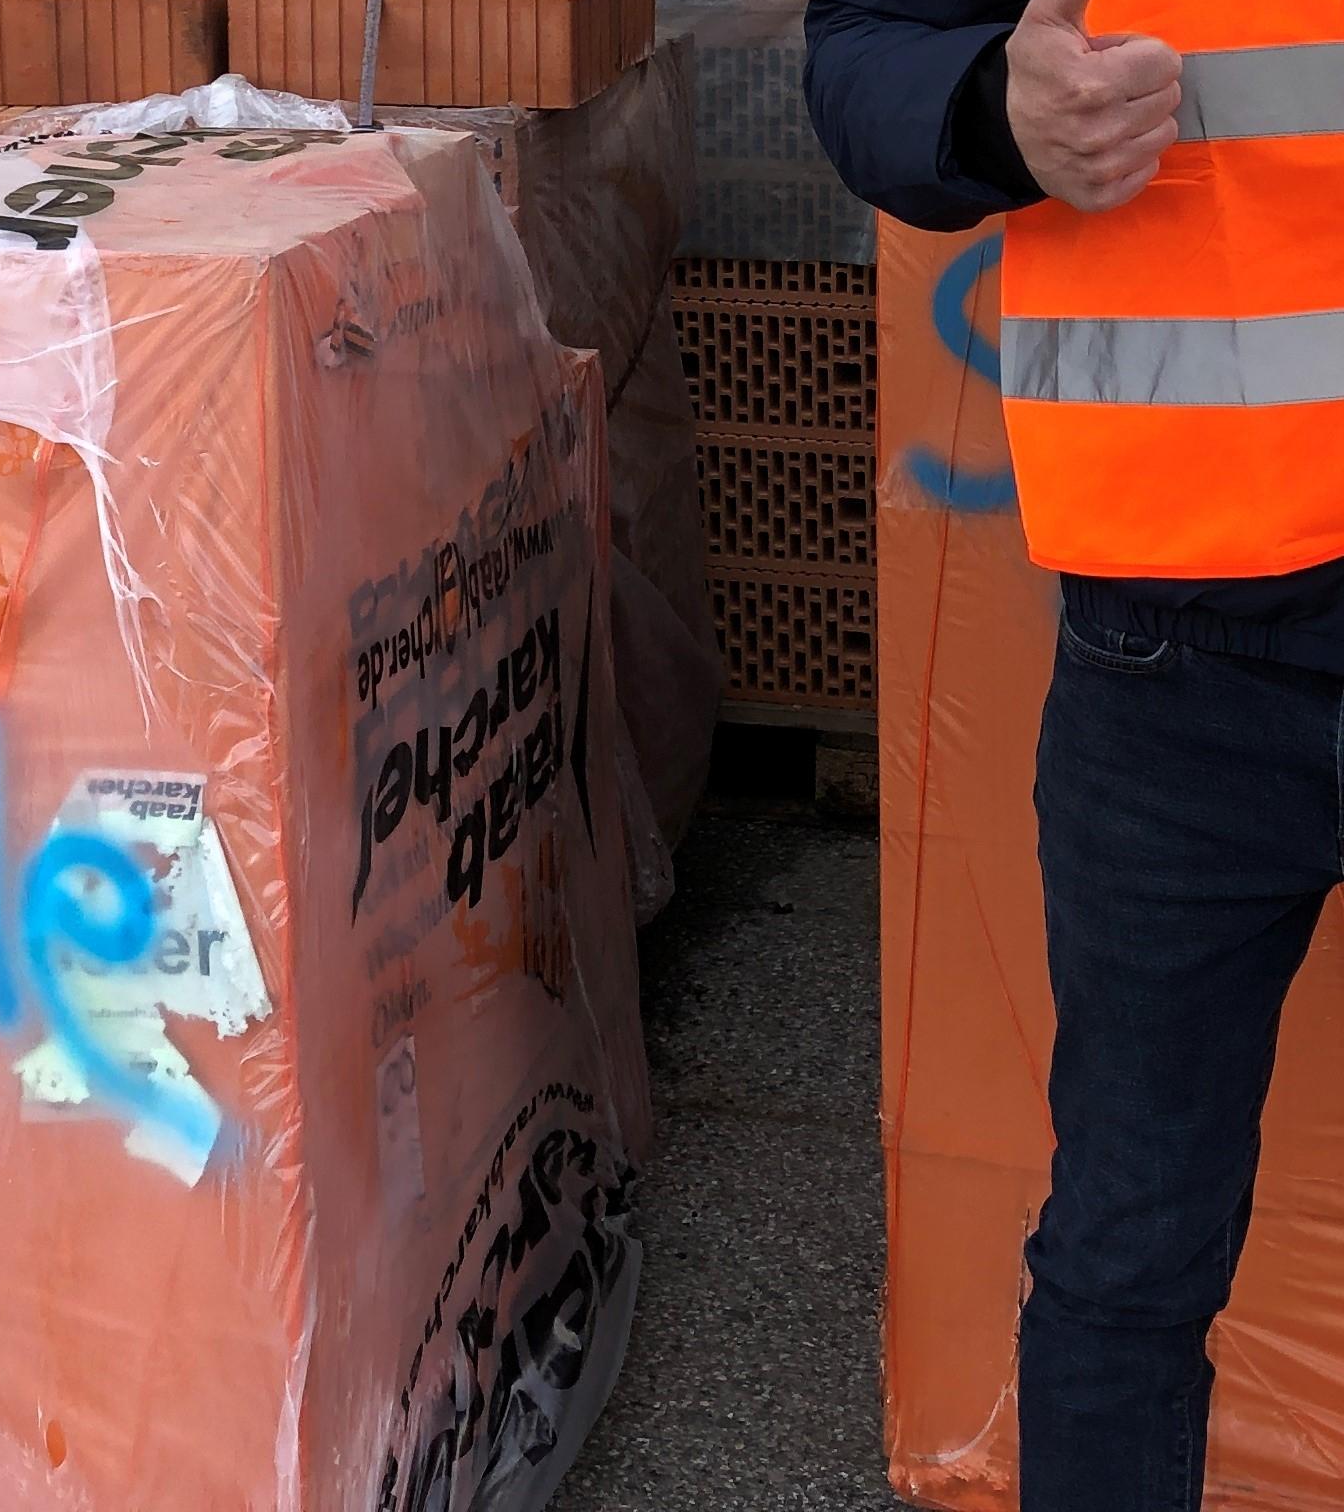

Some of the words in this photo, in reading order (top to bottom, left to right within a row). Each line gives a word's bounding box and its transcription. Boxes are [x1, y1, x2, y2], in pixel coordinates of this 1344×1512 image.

[129, 799, 198, 822] raab
[351, 607, 561, 928] karcher
[447, 698, 563, 910] raab
